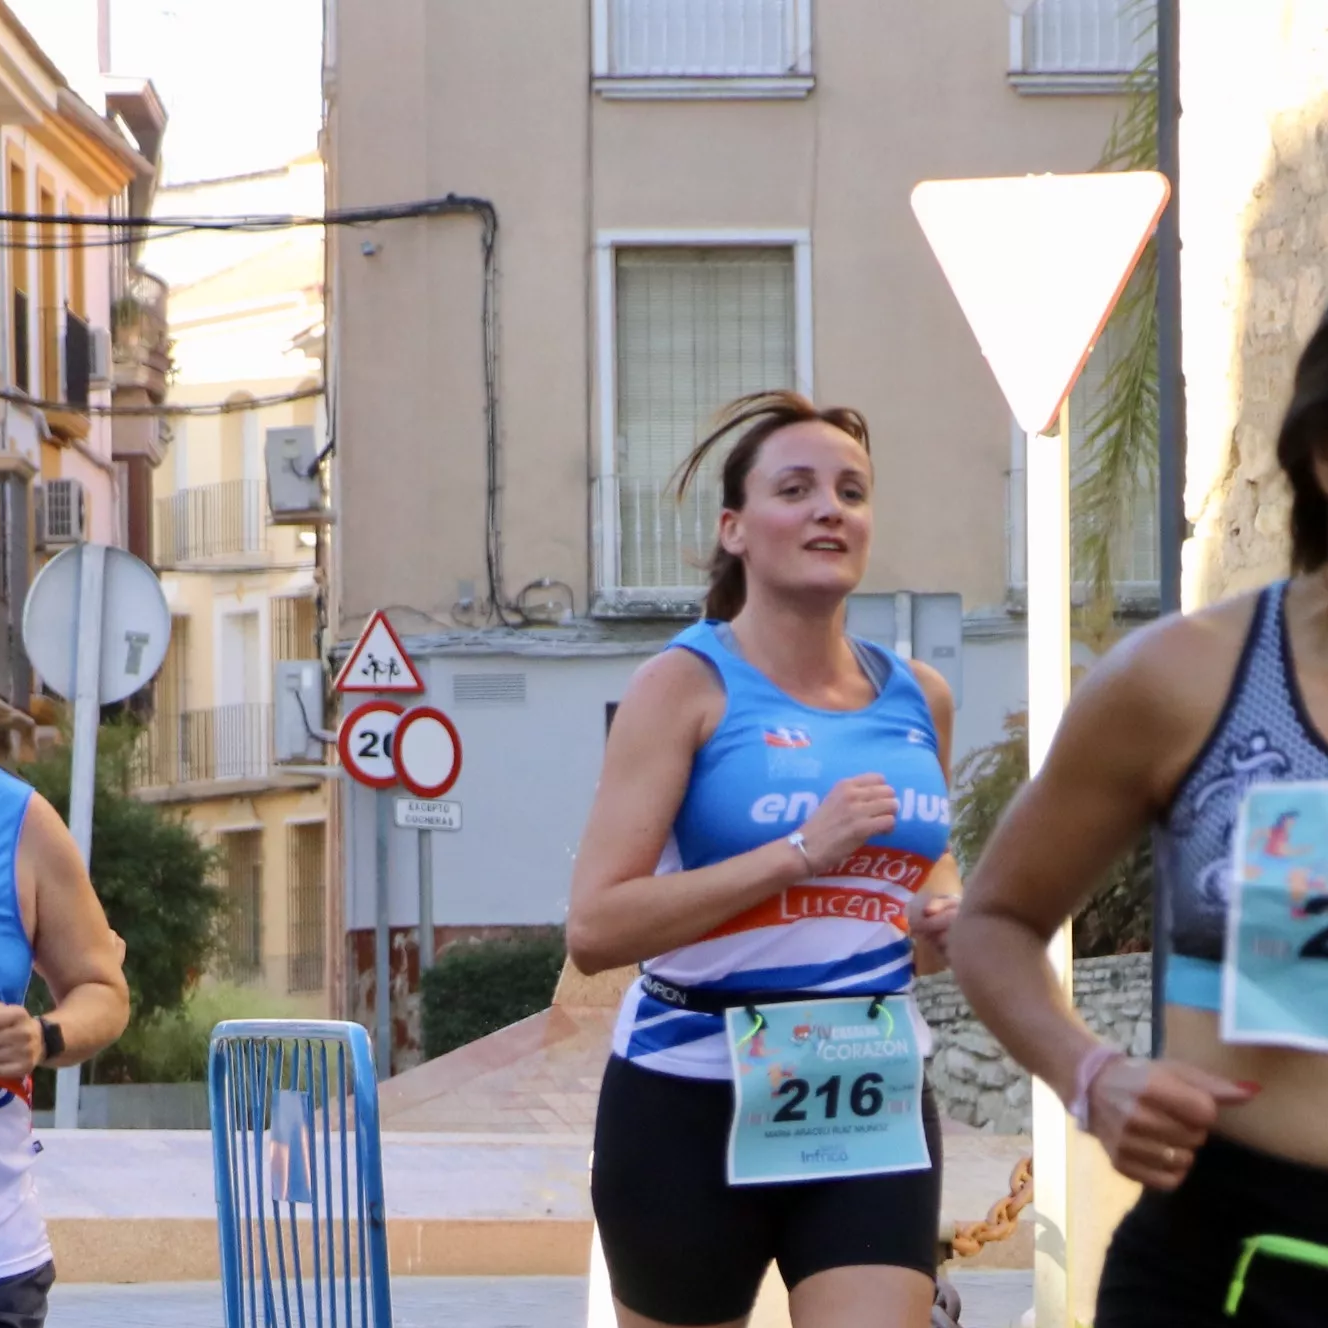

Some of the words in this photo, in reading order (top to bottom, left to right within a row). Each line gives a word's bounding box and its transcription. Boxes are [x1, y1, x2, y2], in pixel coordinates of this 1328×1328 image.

[408, 801, 450, 813] EXCEPTO
[405, 814, 454, 826] COCHERAS
[773, 1072, 884, 1122] 216
